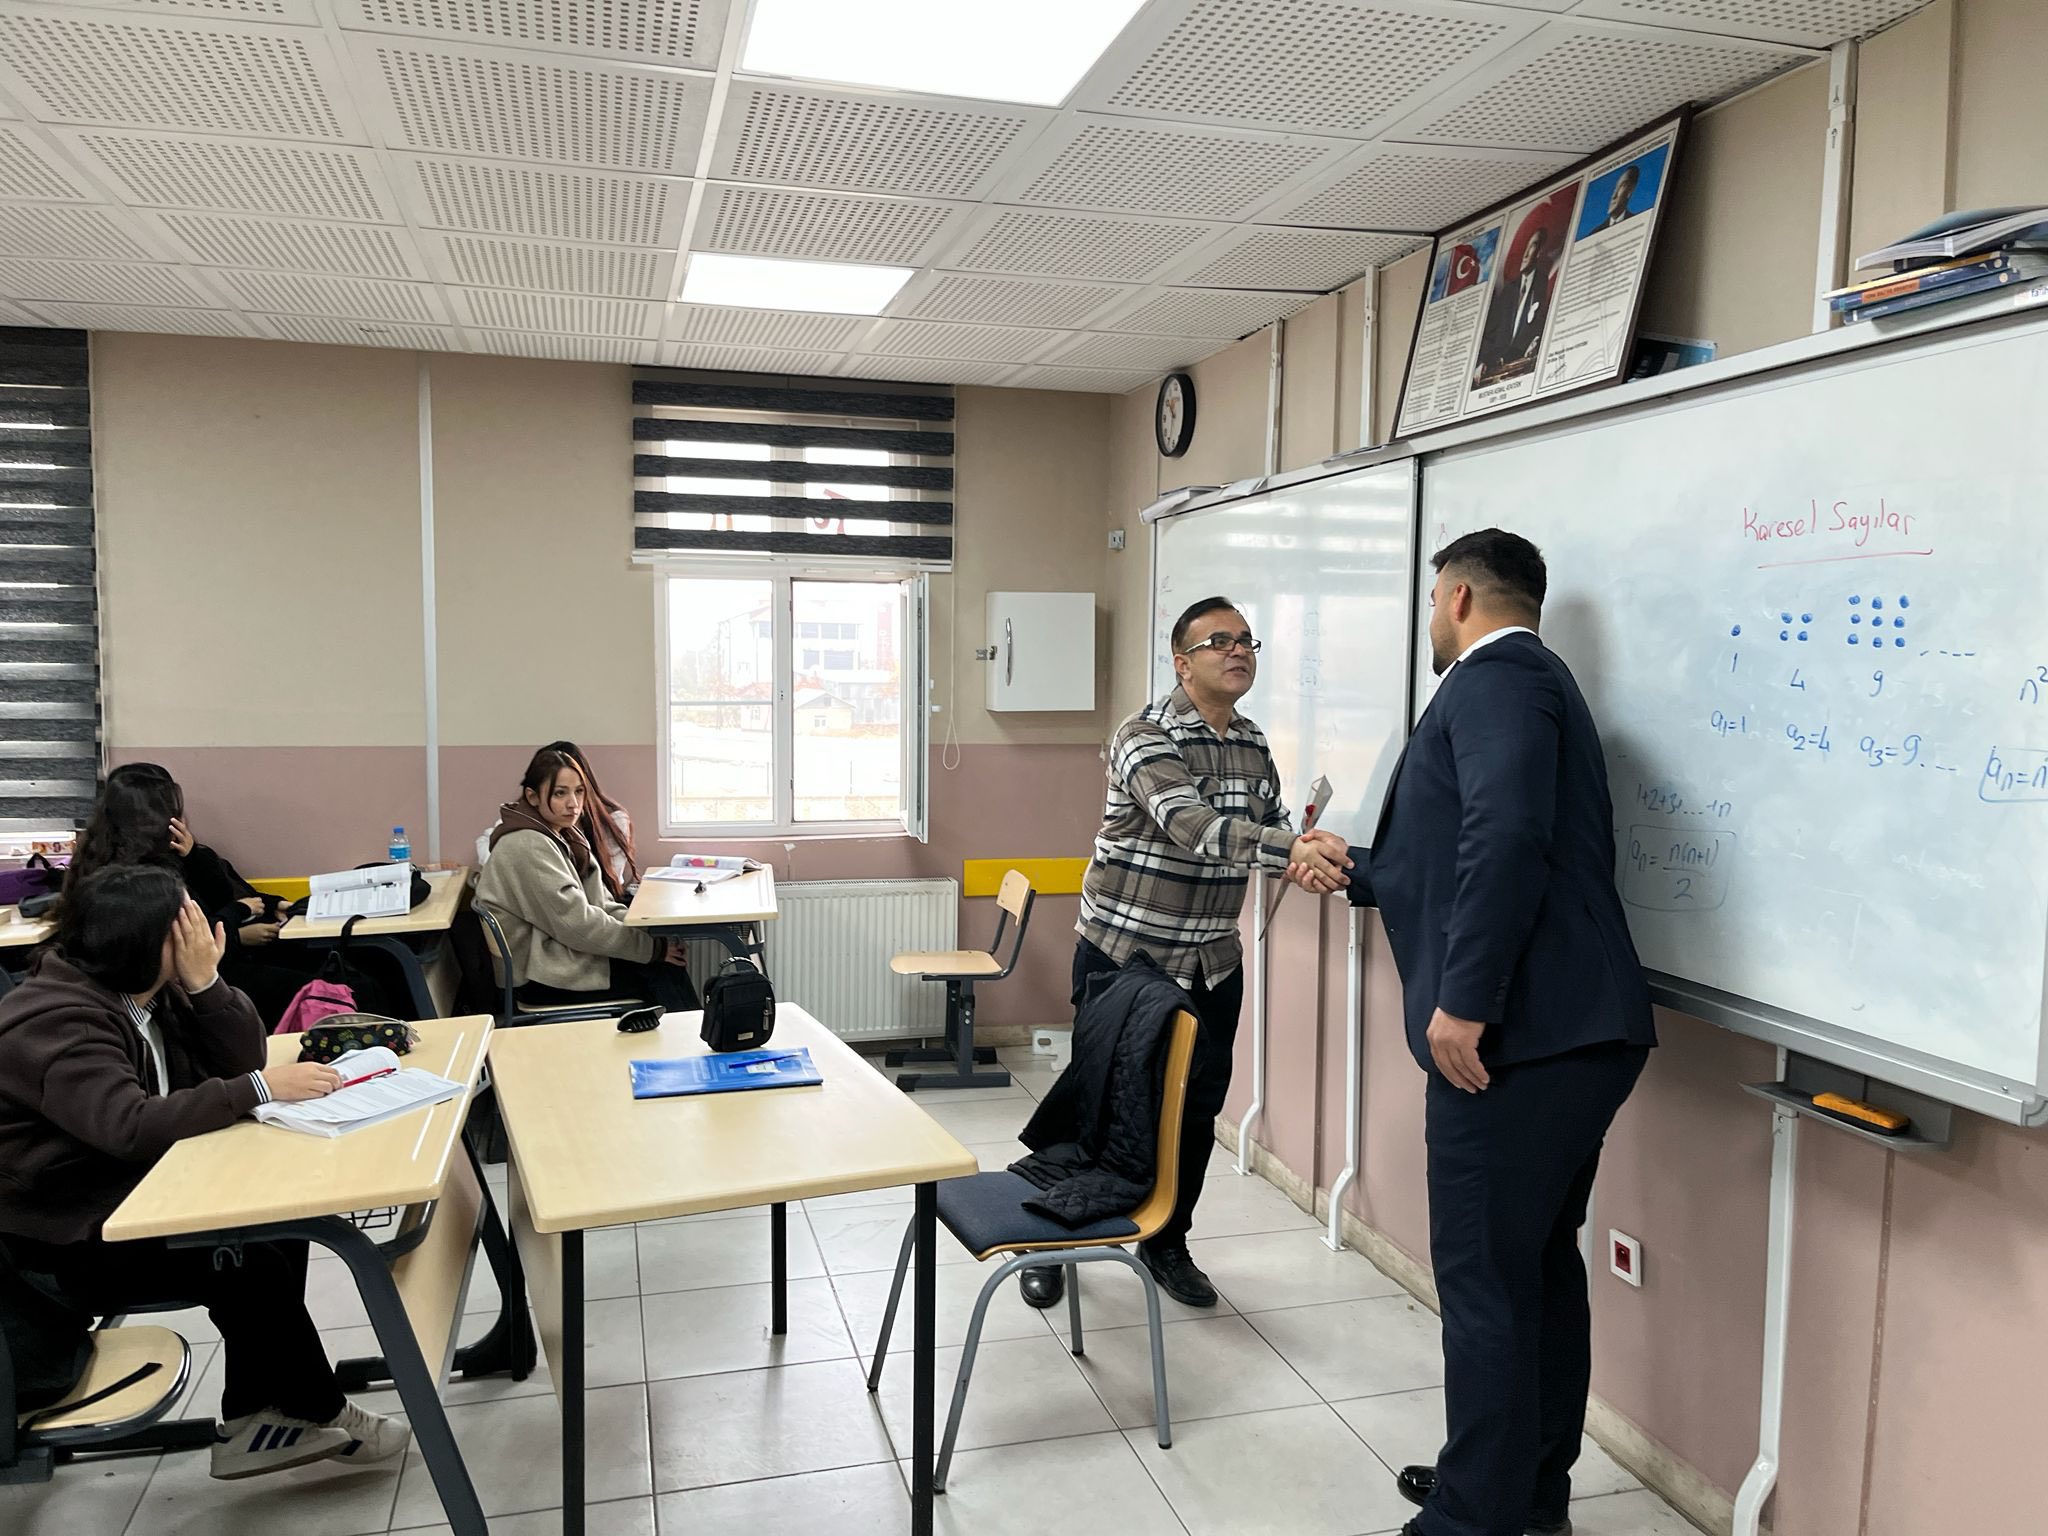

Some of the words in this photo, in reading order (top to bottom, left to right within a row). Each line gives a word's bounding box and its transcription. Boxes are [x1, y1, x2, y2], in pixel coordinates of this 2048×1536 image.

[1743, 499, 1817, 541] Karesel
[1829, 498, 1916, 547] Sayılar
[1789, 668, 1806, 691] 4
[1868, 670, 1884, 697] 9
